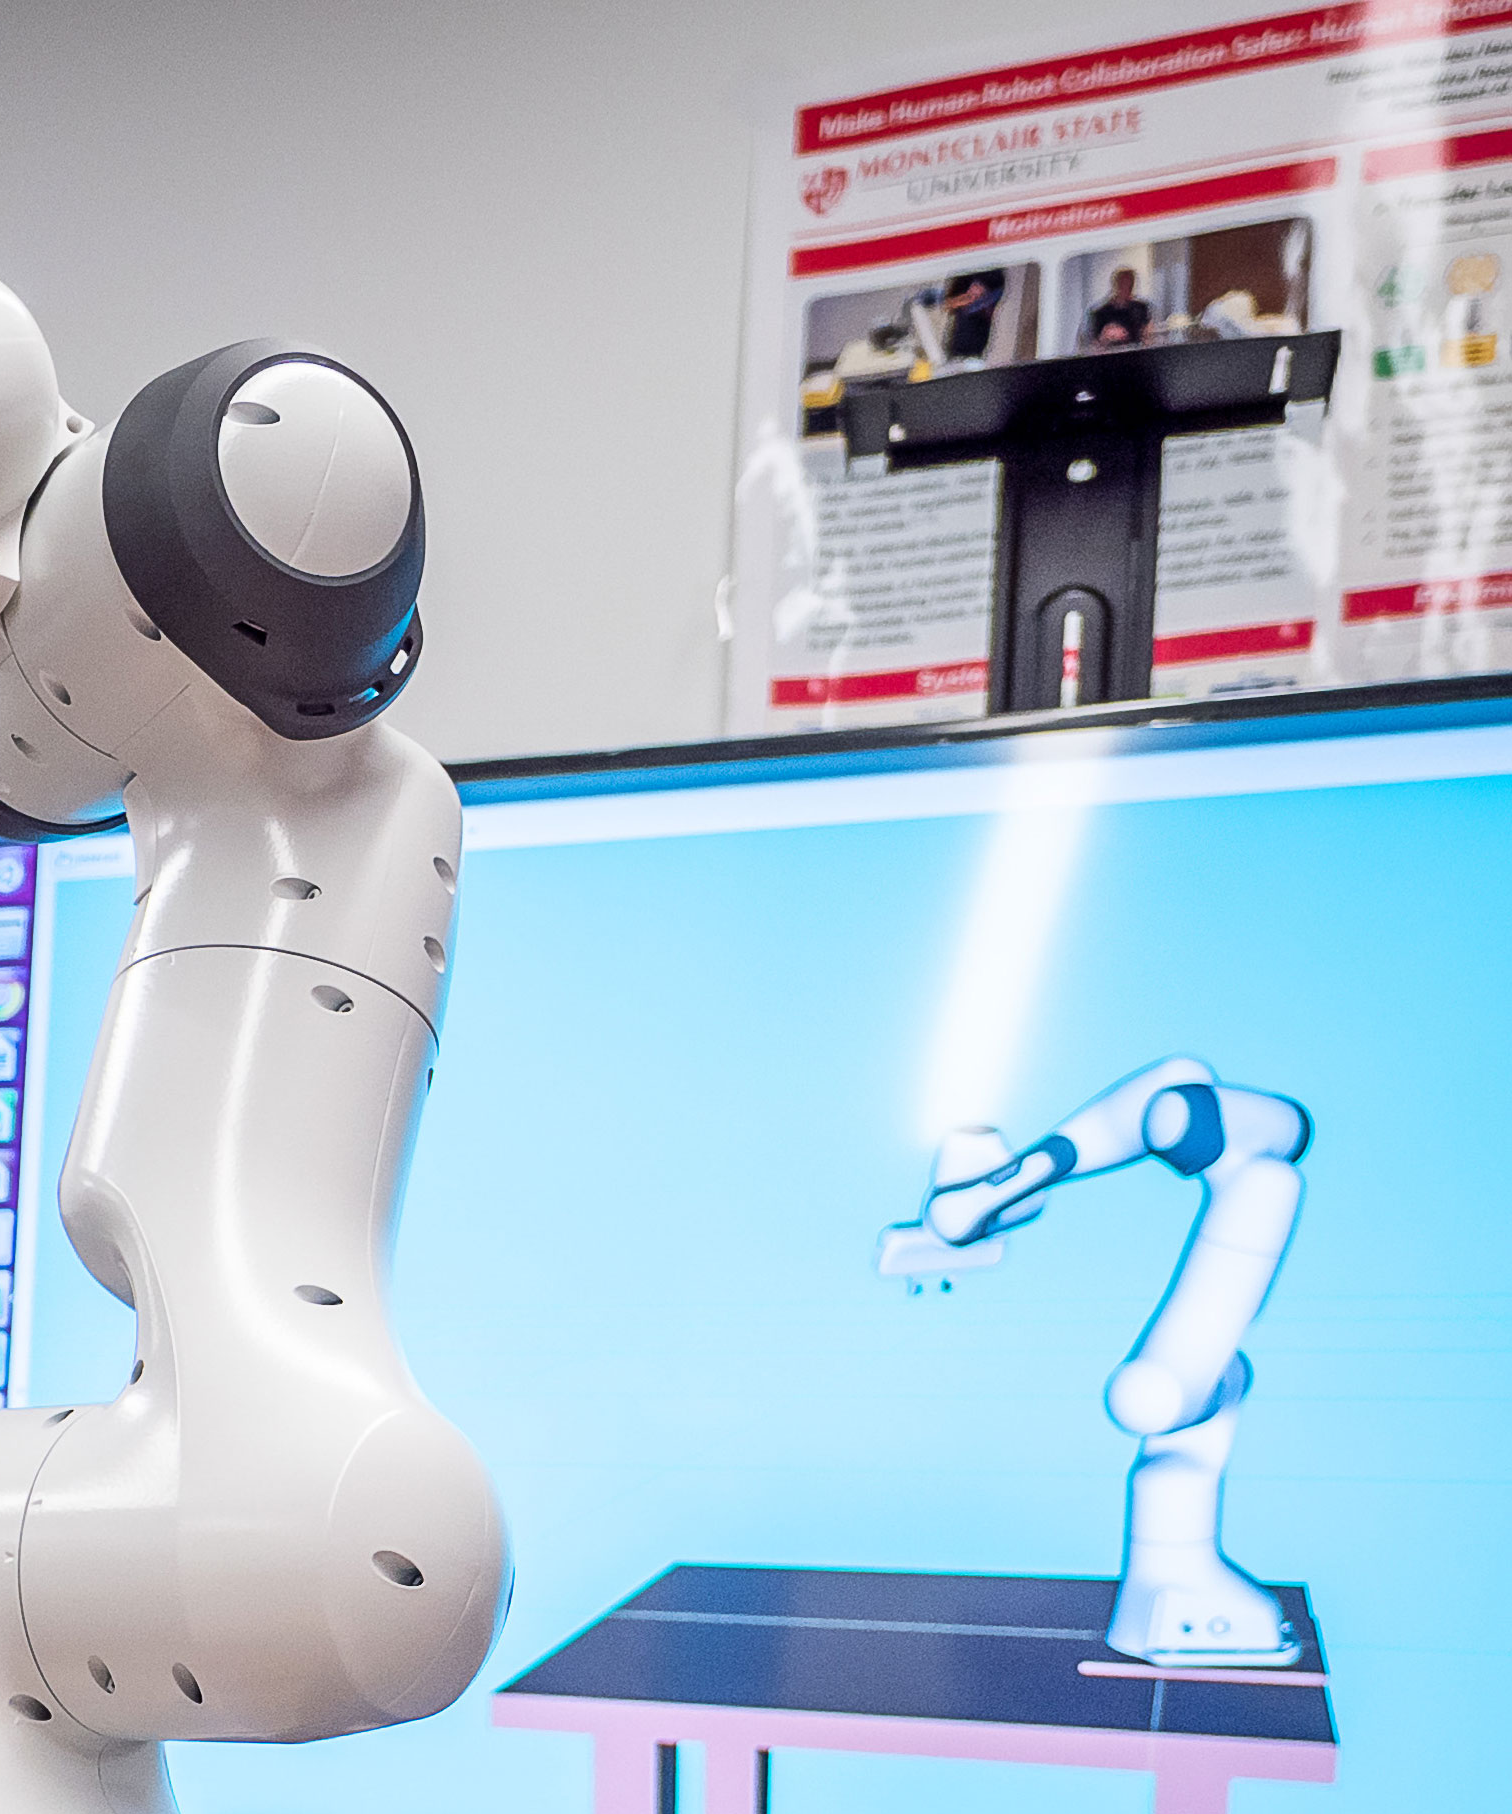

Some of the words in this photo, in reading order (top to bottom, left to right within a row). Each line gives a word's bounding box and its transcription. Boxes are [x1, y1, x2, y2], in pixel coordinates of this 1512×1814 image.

[855, 123, 1043, 180] MONTCLAIR
[1052, 105, 1143, 142] STATE
[907, 151, 1082, 202] UNIVERSITY
